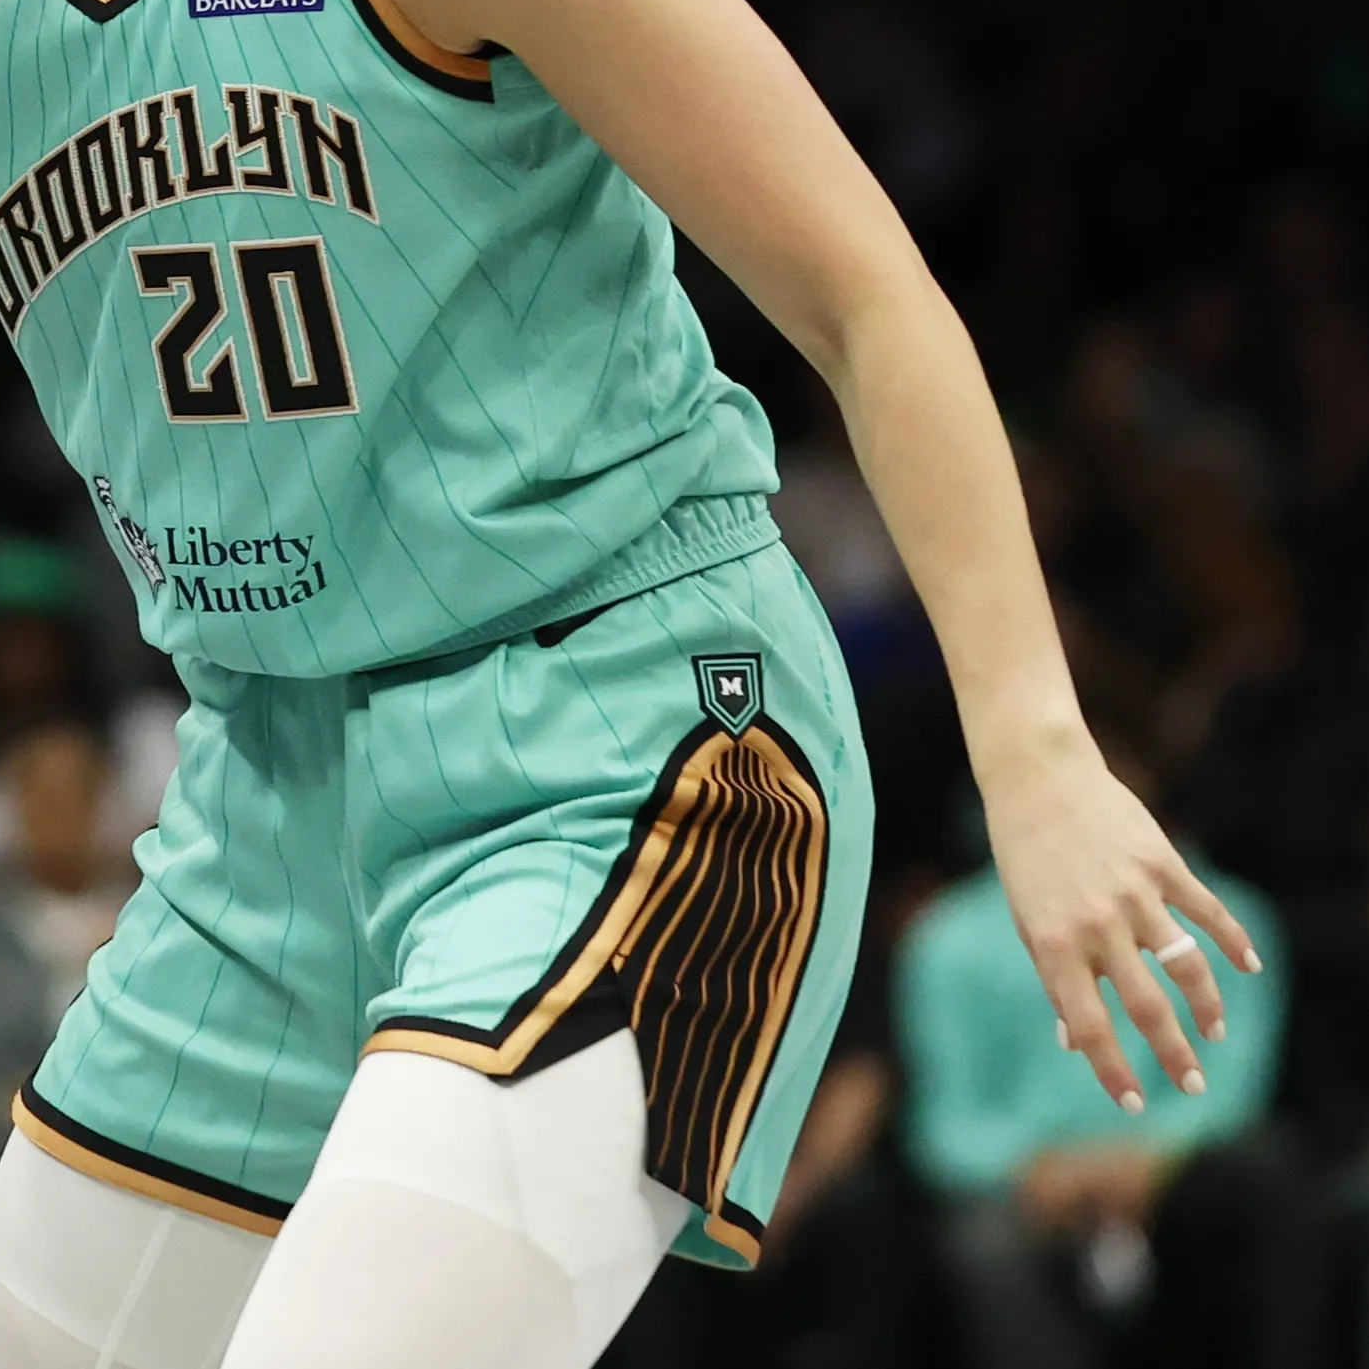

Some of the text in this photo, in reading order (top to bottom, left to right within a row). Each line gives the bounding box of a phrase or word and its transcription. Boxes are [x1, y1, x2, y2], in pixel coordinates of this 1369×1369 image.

[127, 236, 360, 423] 20
[164, 527, 314, 576] Liberty
[172, 561, 327, 613] Mutual
[718, 676, 745, 696] M
